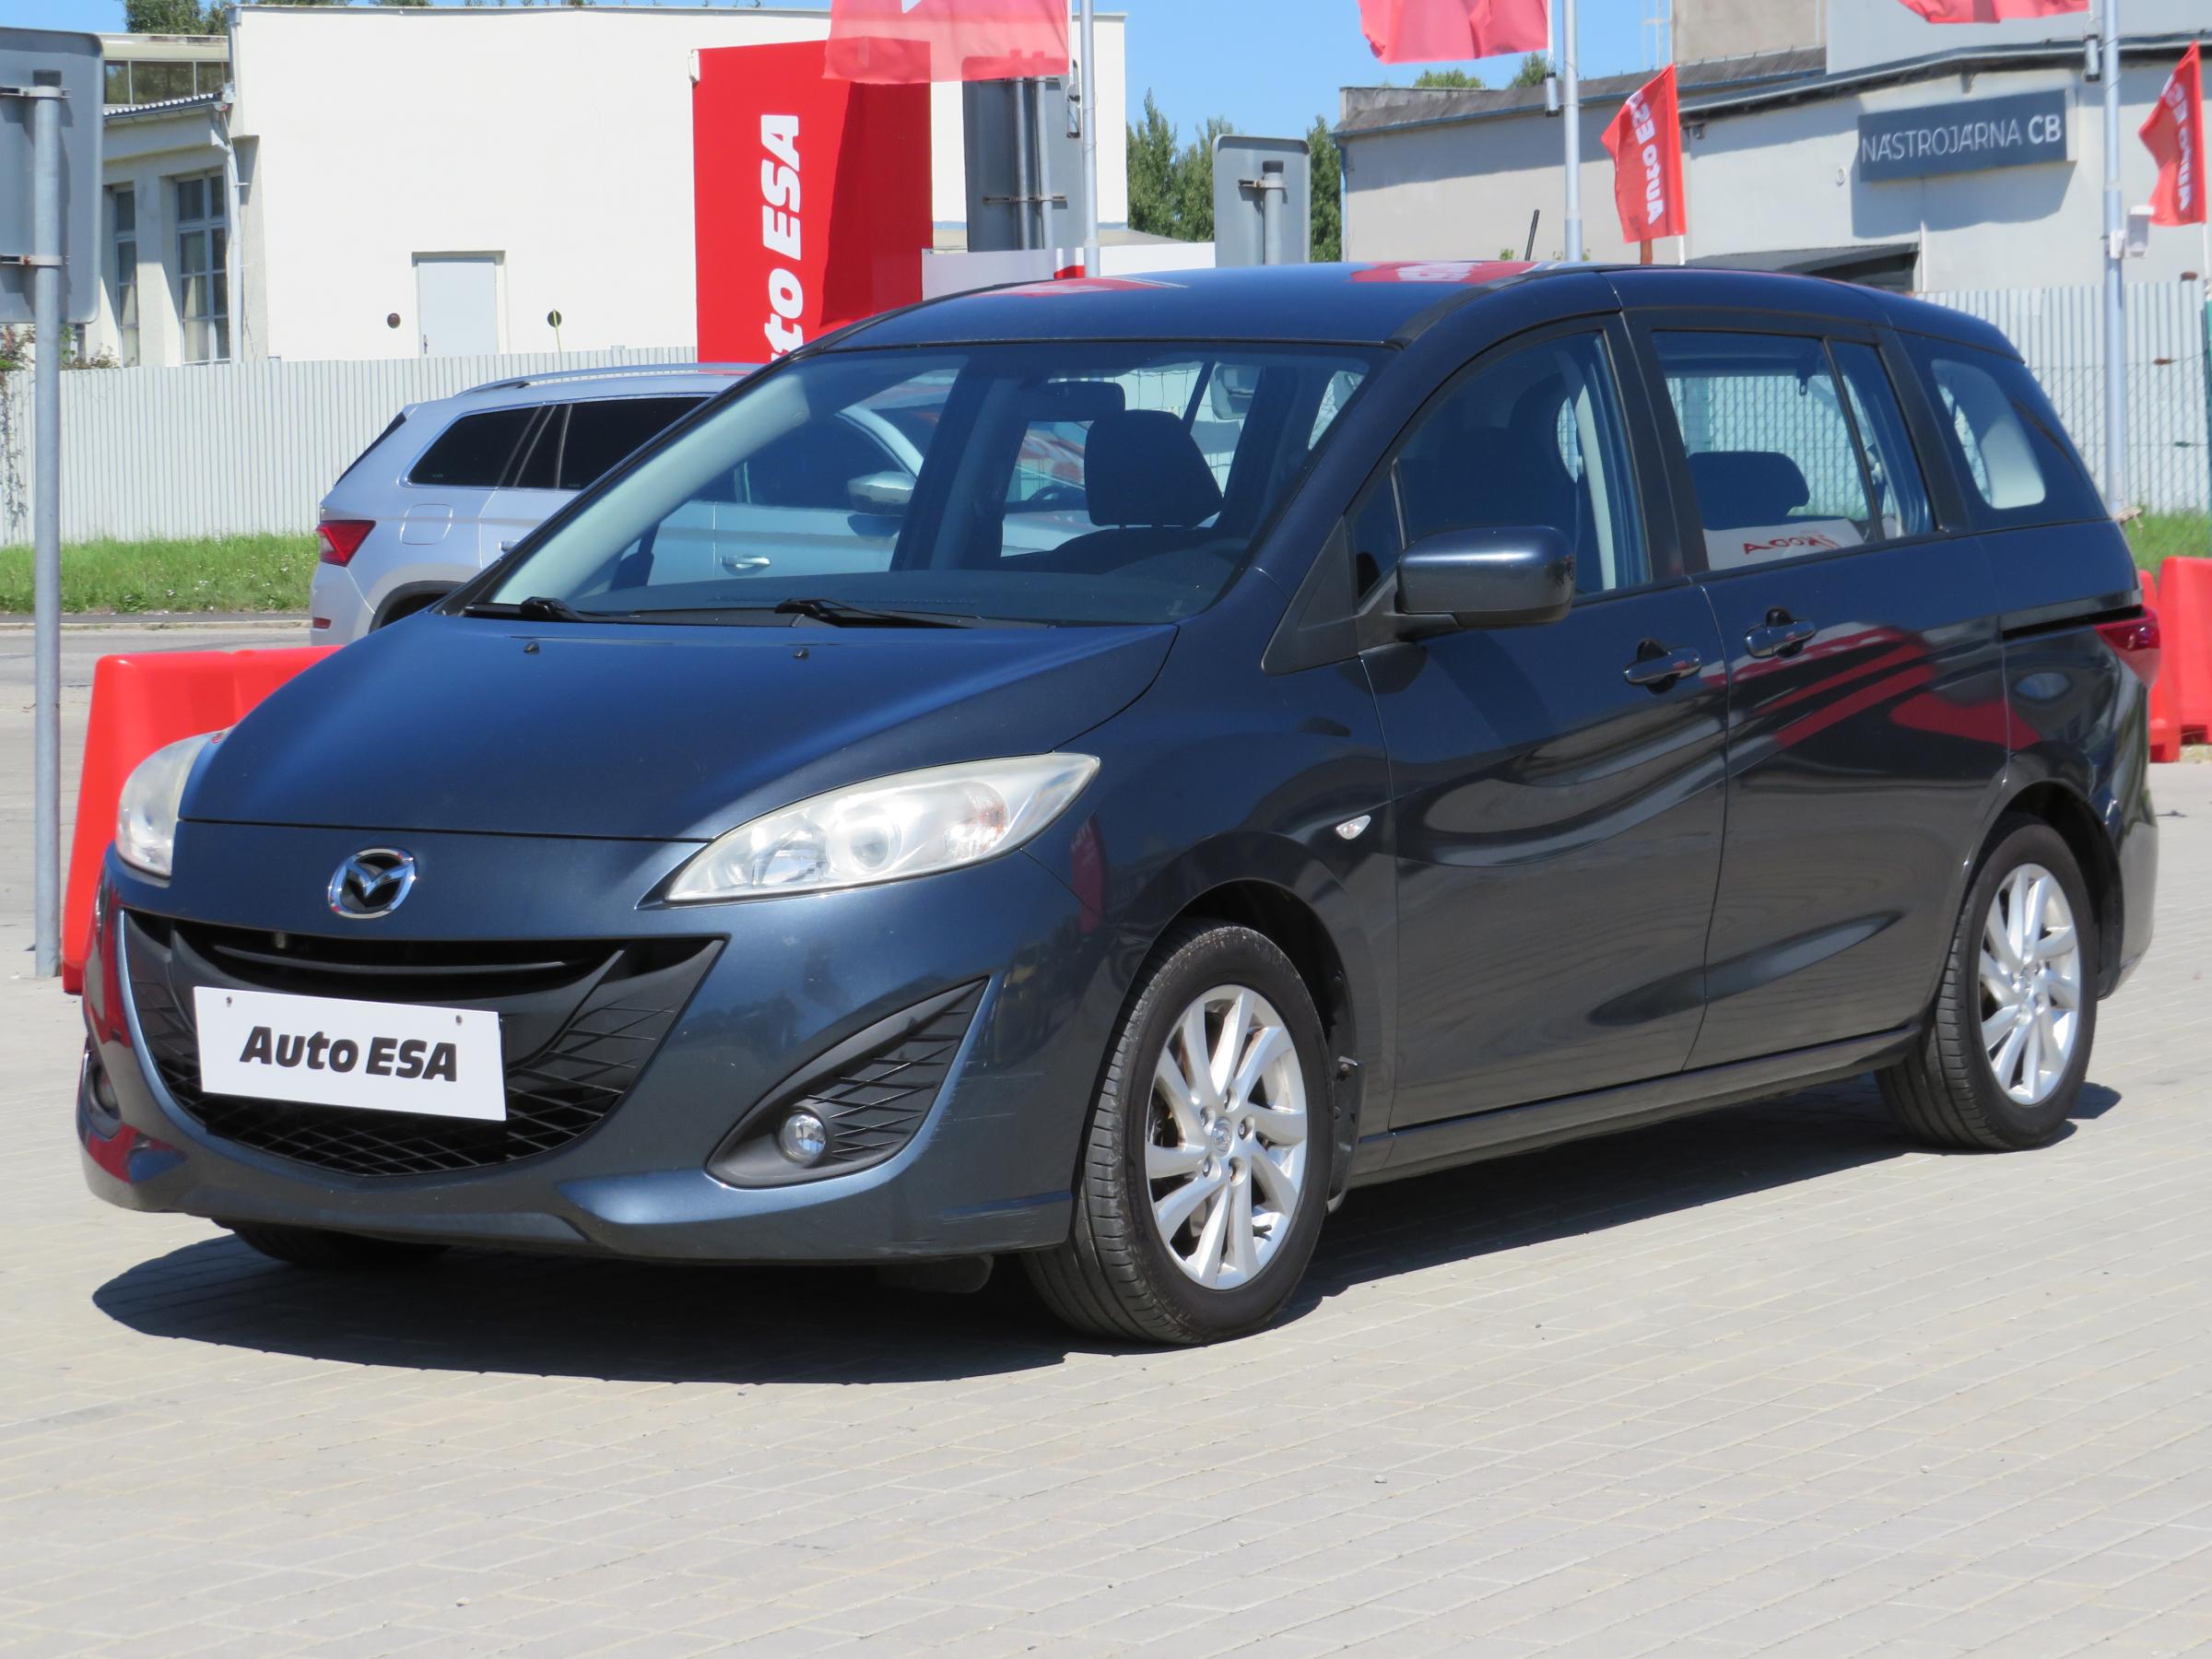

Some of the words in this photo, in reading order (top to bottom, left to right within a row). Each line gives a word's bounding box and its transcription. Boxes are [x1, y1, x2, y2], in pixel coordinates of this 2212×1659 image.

[1862, 118, 2023, 163] NÁSTROJÁRNA
[2028, 113, 2063, 145] CB
[760, 113, 802, 261] ESA
[764, 267, 804, 362] to
[239, 1025, 359, 1073] Auto
[365, 1036, 457, 1082] ESA
